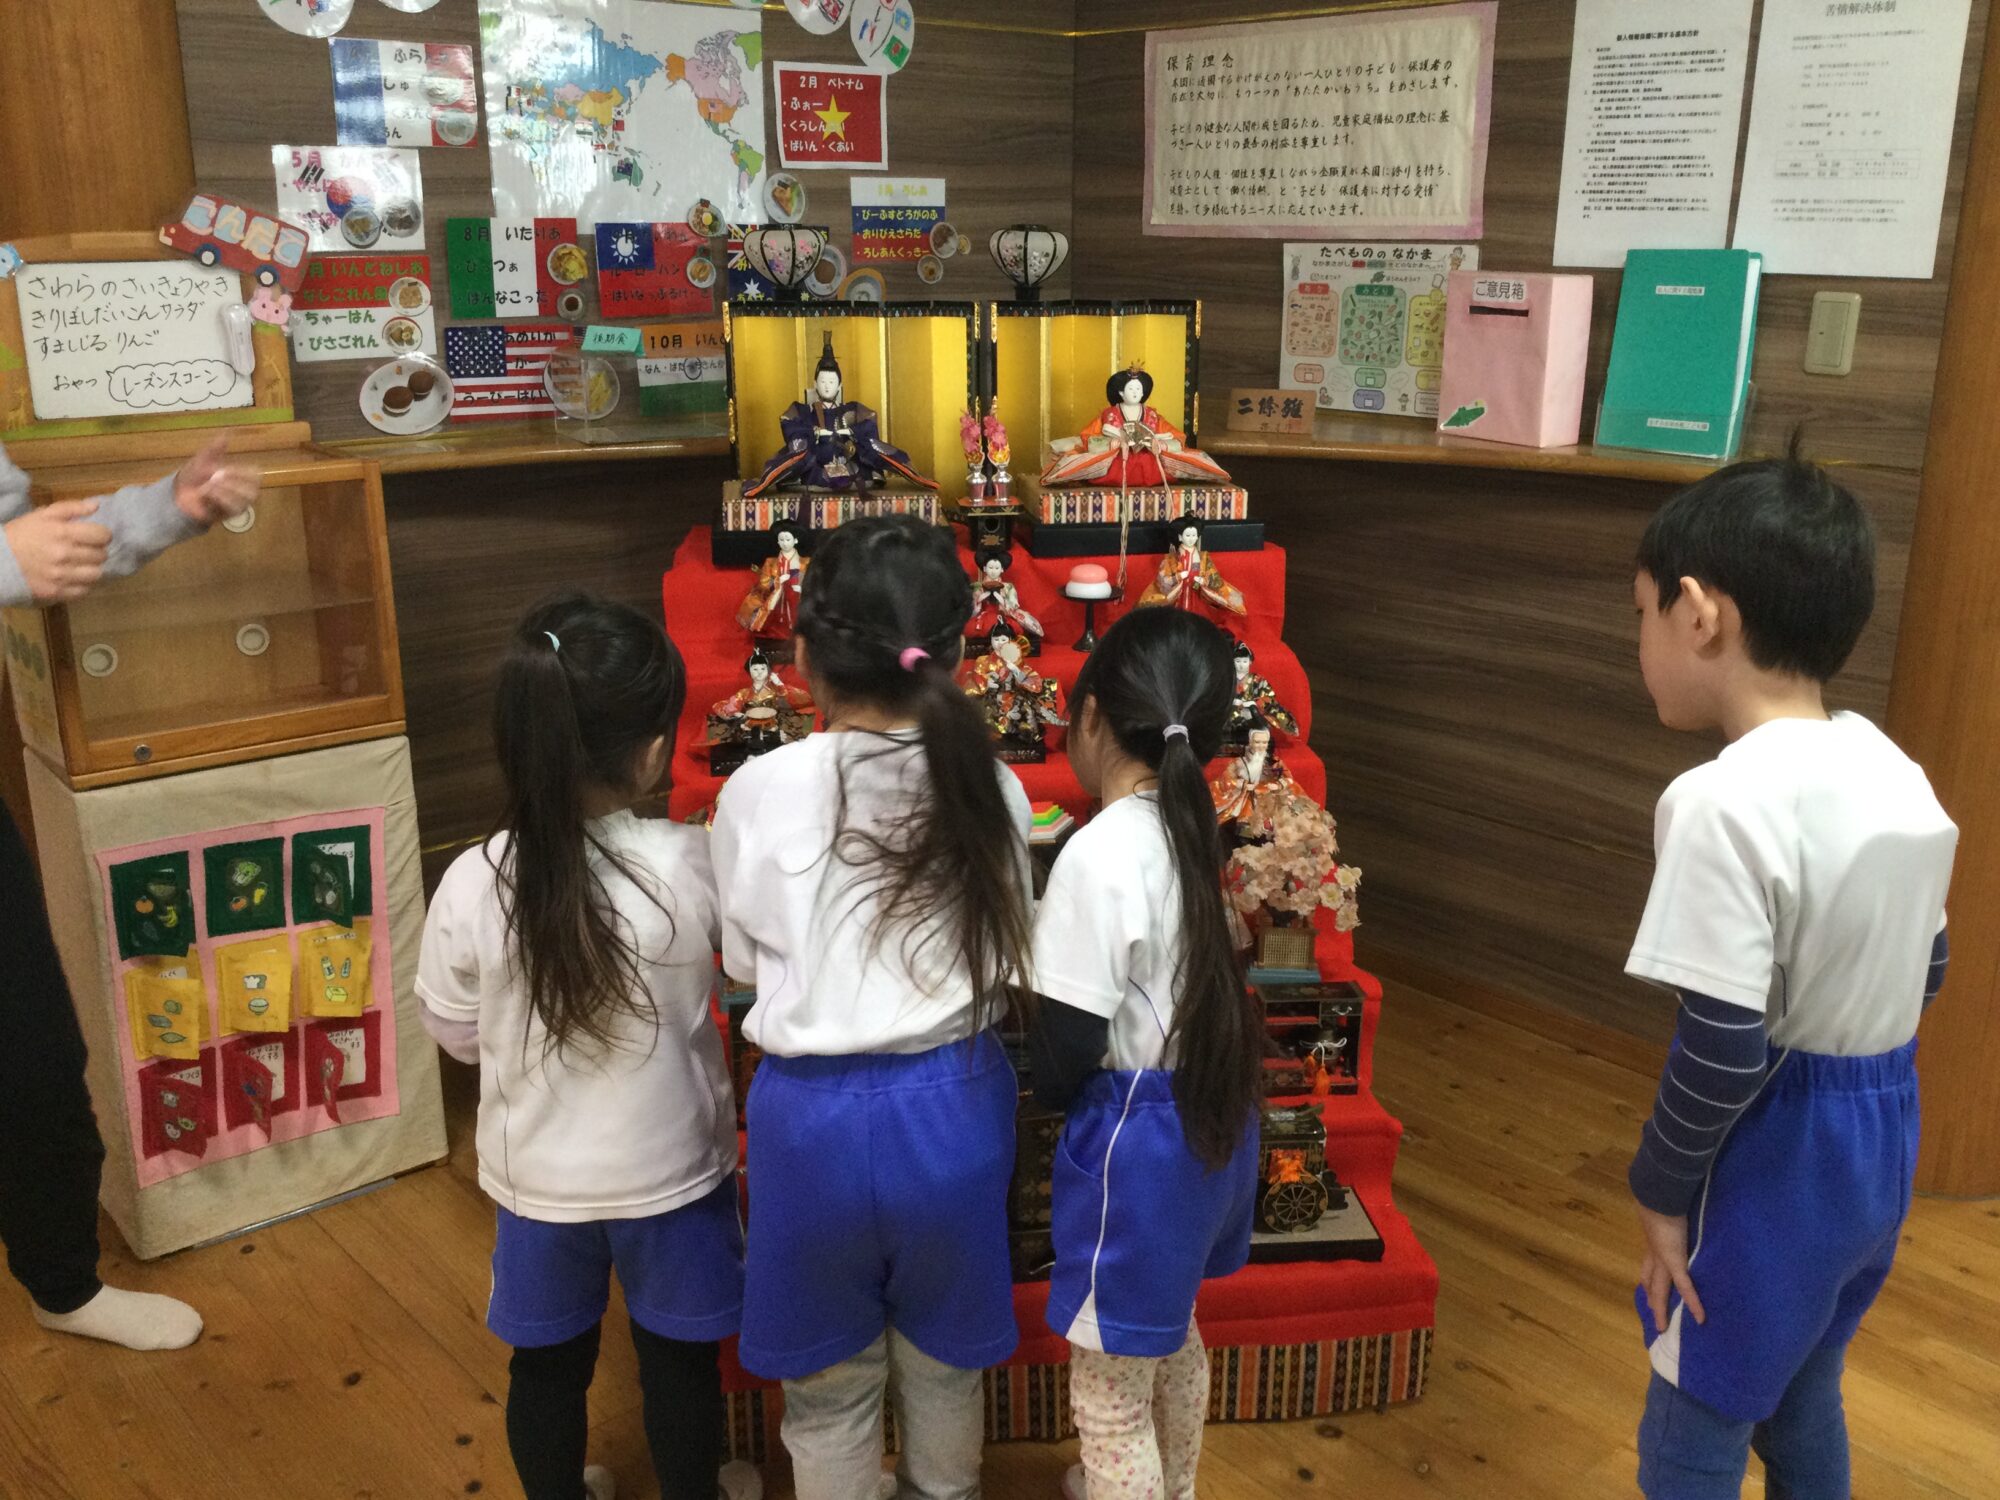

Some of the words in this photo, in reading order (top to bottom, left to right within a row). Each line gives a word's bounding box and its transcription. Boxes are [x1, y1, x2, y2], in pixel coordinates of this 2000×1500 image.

[1167, 52, 1235, 72] 保育理念
[799, 75, 818, 89] 2月
[827, 77, 865, 91] ベトナム
[181, 194, 309, 268] こんだて
[463, 226, 490, 241] 8月
[505, 226, 561, 241] いたりあ
[1320, 246, 1433, 261] たべもののなかま
[331, 260, 425, 277] いんどねしあ
[27, 273, 230, 302] さわらのさいきょうやき
[1475, 279, 1525, 300] ご意見箱
[31, 300, 206, 333] きりぼしだいこんサラダ
[304, 309, 377, 326] ちゃーはん
[650, 334, 682, 349] 10月
[53, 374, 98, 392] おやつ
[122, 368, 219, 397] レーズンスコーン
